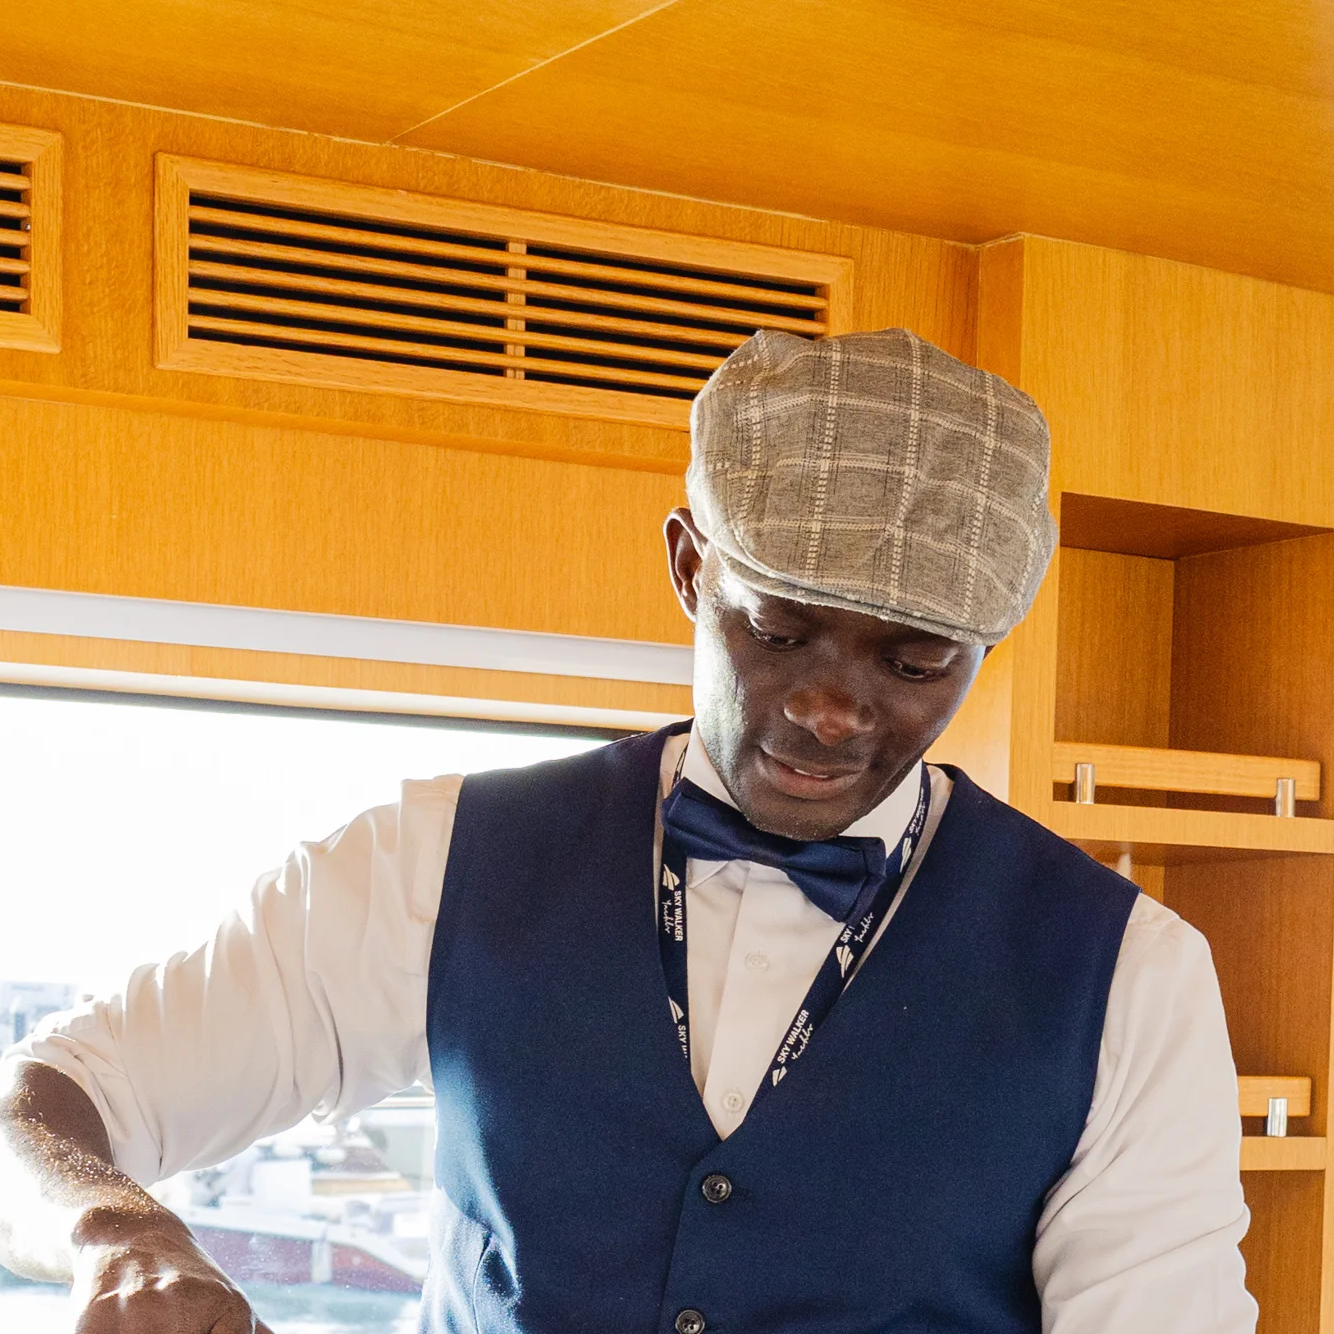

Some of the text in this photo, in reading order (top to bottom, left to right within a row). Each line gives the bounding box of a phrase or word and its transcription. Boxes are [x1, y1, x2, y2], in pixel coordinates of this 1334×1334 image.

[674, 890, 684, 941] SKY WALKER
[840, 928, 852, 944] SKY
[678, 1025, 687, 1044] SKY
[777, 1009, 810, 1064] SKY WALKER
